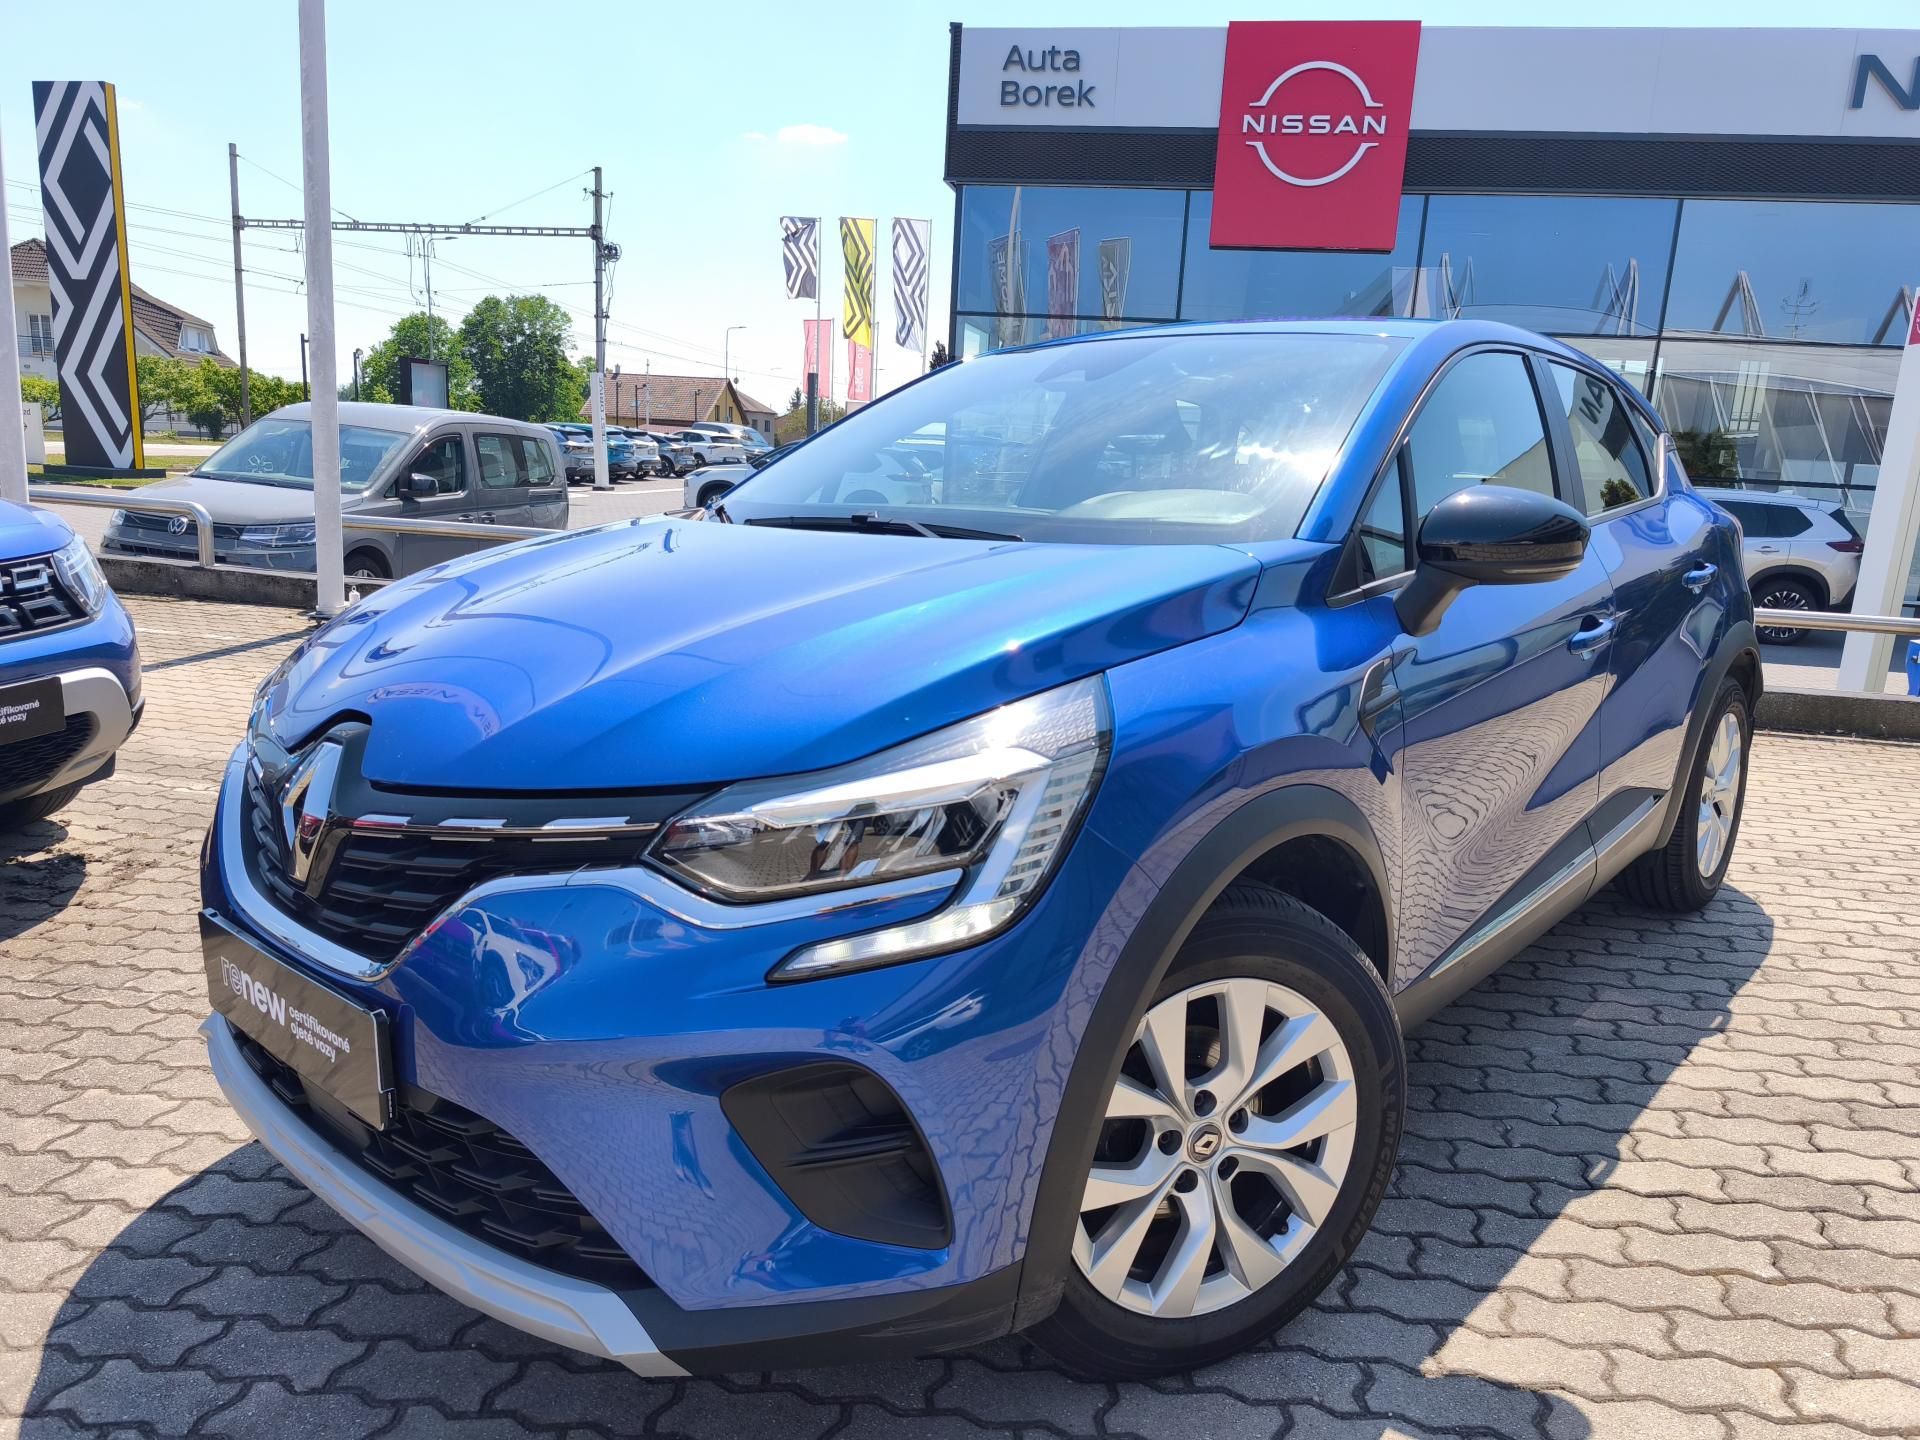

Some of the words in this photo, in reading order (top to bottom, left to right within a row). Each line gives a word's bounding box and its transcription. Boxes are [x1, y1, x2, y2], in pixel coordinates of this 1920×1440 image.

[1003, 44, 1081, 72] Auta
[999, 79, 1096, 108] Borek
[1243, 114, 1387, 136] NISSAN
[0, 699, 40, 716] ifikované
[7, 712, 27, 723] vozy
[221, 955, 286, 1026] renew
[289, 1006, 351, 1053] certifikované
[290, 1022, 314, 1046] ojeté
[314, 1038, 336, 1064] vozy
[1349, 1110, 1398, 1244] MICHELIN
